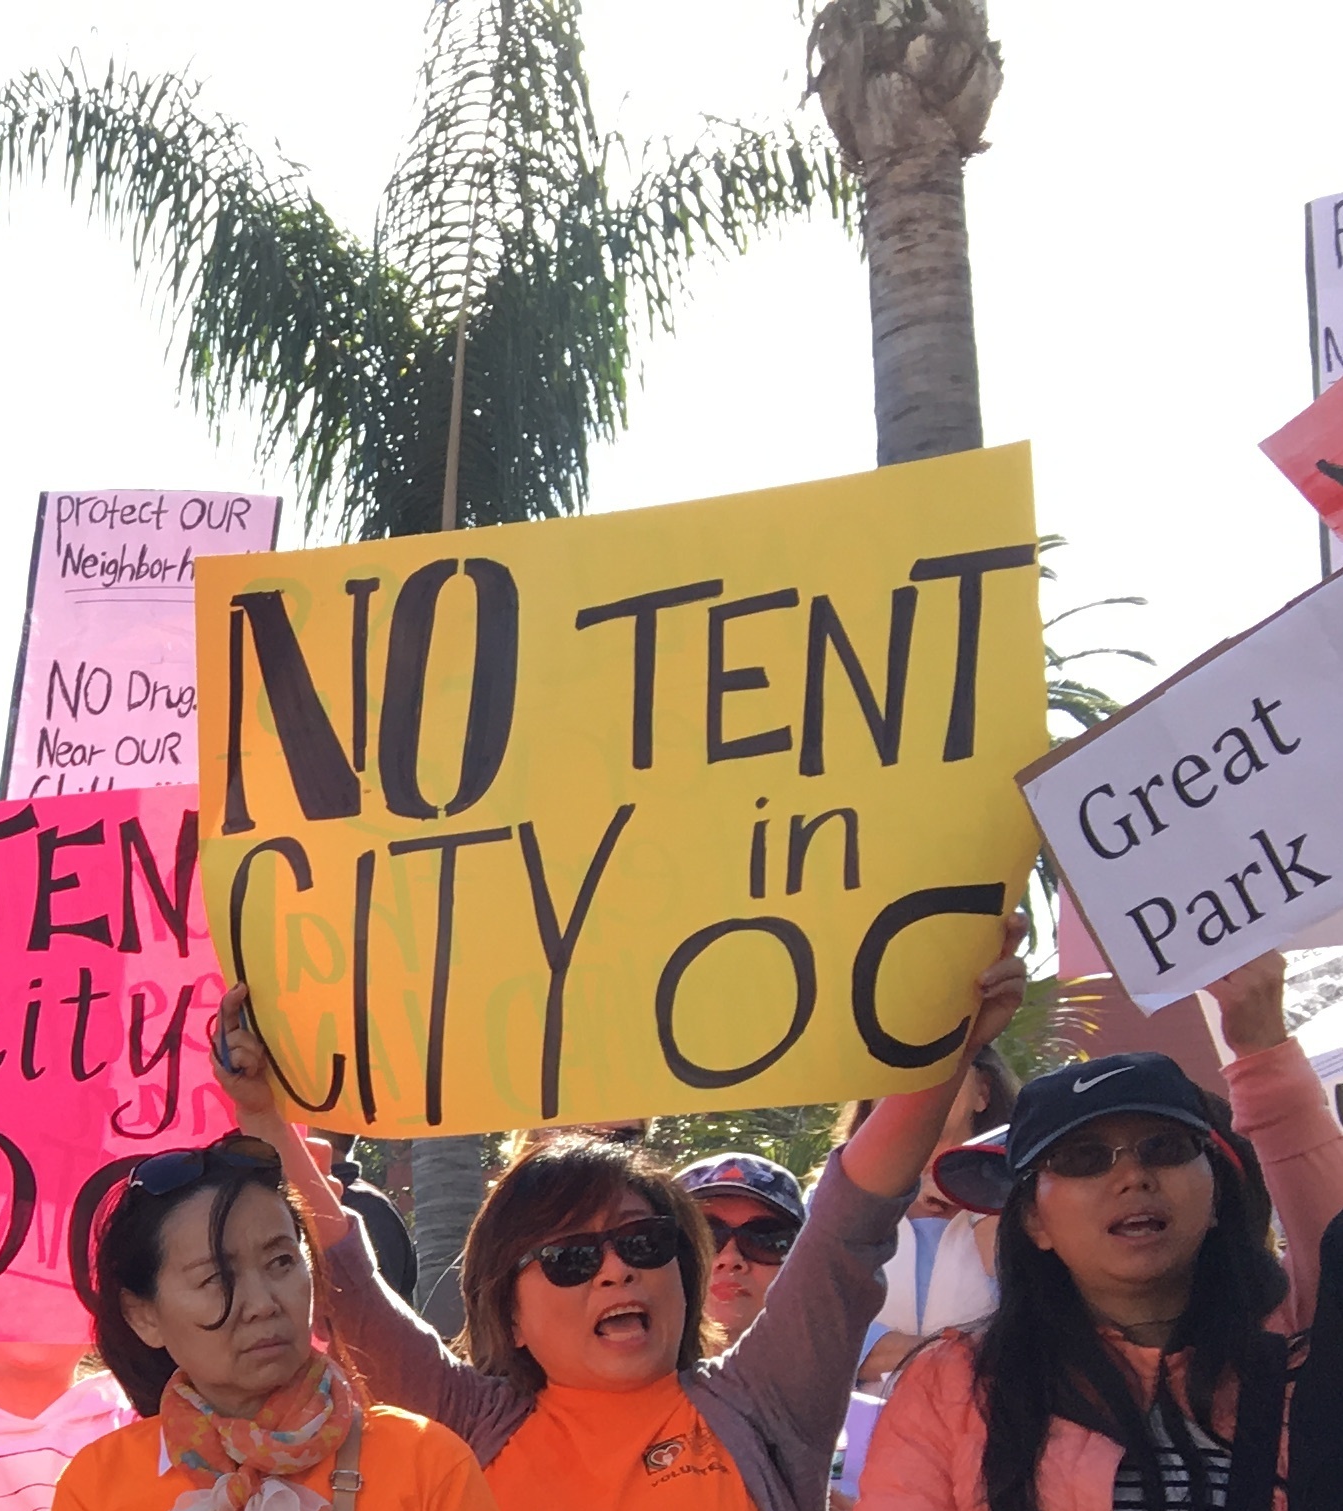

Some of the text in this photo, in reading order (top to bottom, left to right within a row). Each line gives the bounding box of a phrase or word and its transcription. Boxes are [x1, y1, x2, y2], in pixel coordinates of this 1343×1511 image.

[61, 543, 195, 588] Neighborh
[180, 497, 251, 533] OUR
[37, 726, 182, 769] Near OUR
[46, 659, 198, 722] NO Drug
[222, 543, 1037, 835] NO TENT
[1078, 696, 1302, 861] Great
[230, 797, 861, 1126] CITY in
[1124, 828, 1332, 975] Park
[655, 882, 1006, 1090] OC
